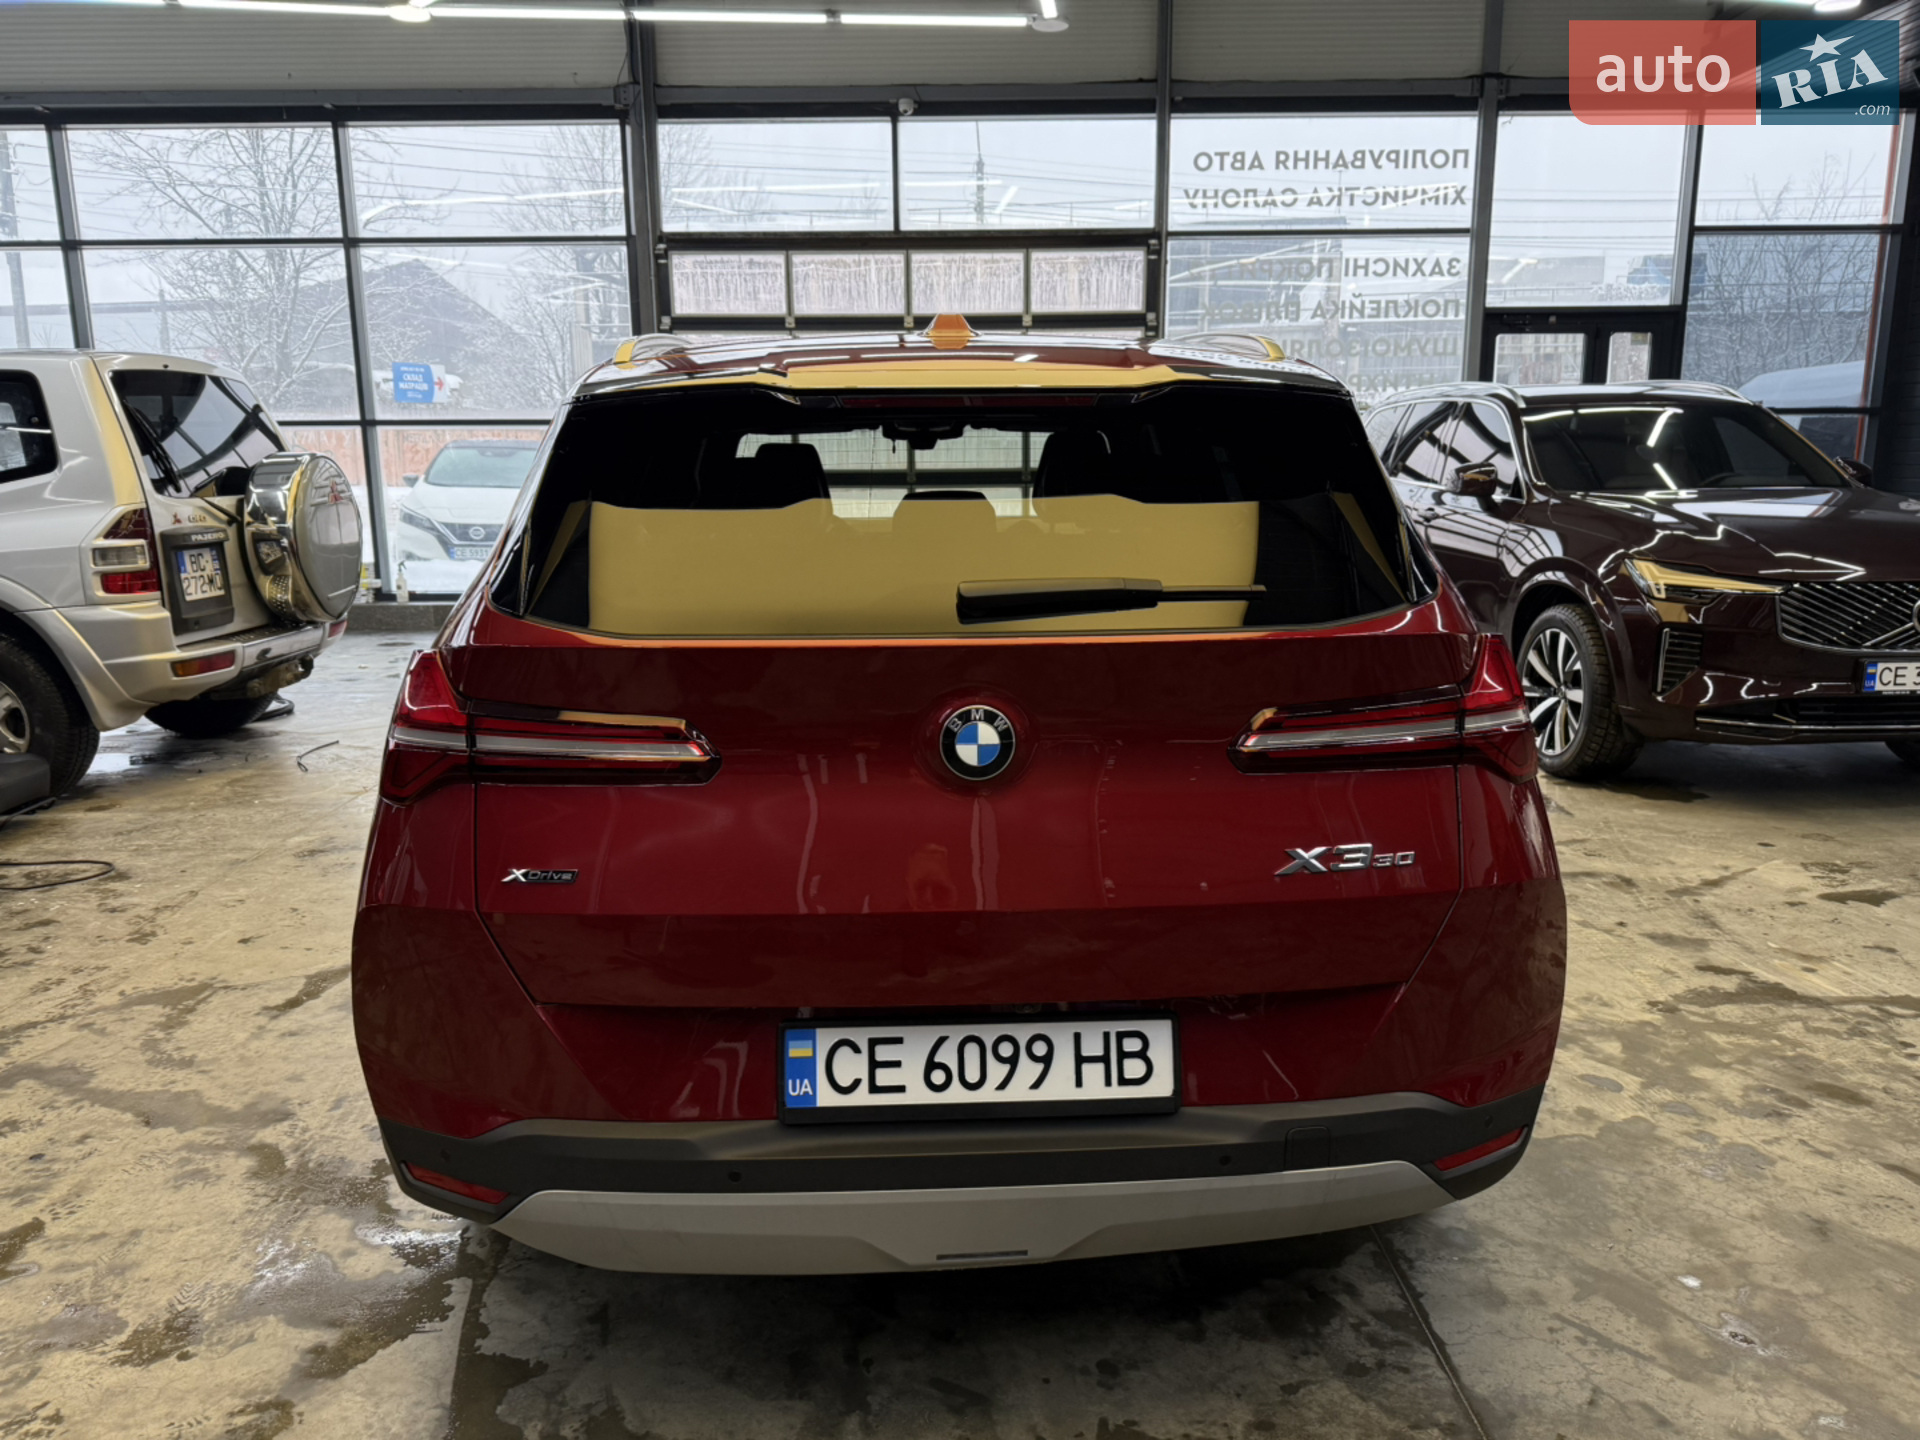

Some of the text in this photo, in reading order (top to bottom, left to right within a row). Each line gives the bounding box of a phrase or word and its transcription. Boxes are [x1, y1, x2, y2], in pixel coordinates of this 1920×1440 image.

[455, 548, 467, 557] CE
[1878, 666, 1908, 687] CE
[947, 708, 1009, 733] BMW
[787, 1030, 1154, 1096] UA CE 6099 HB
